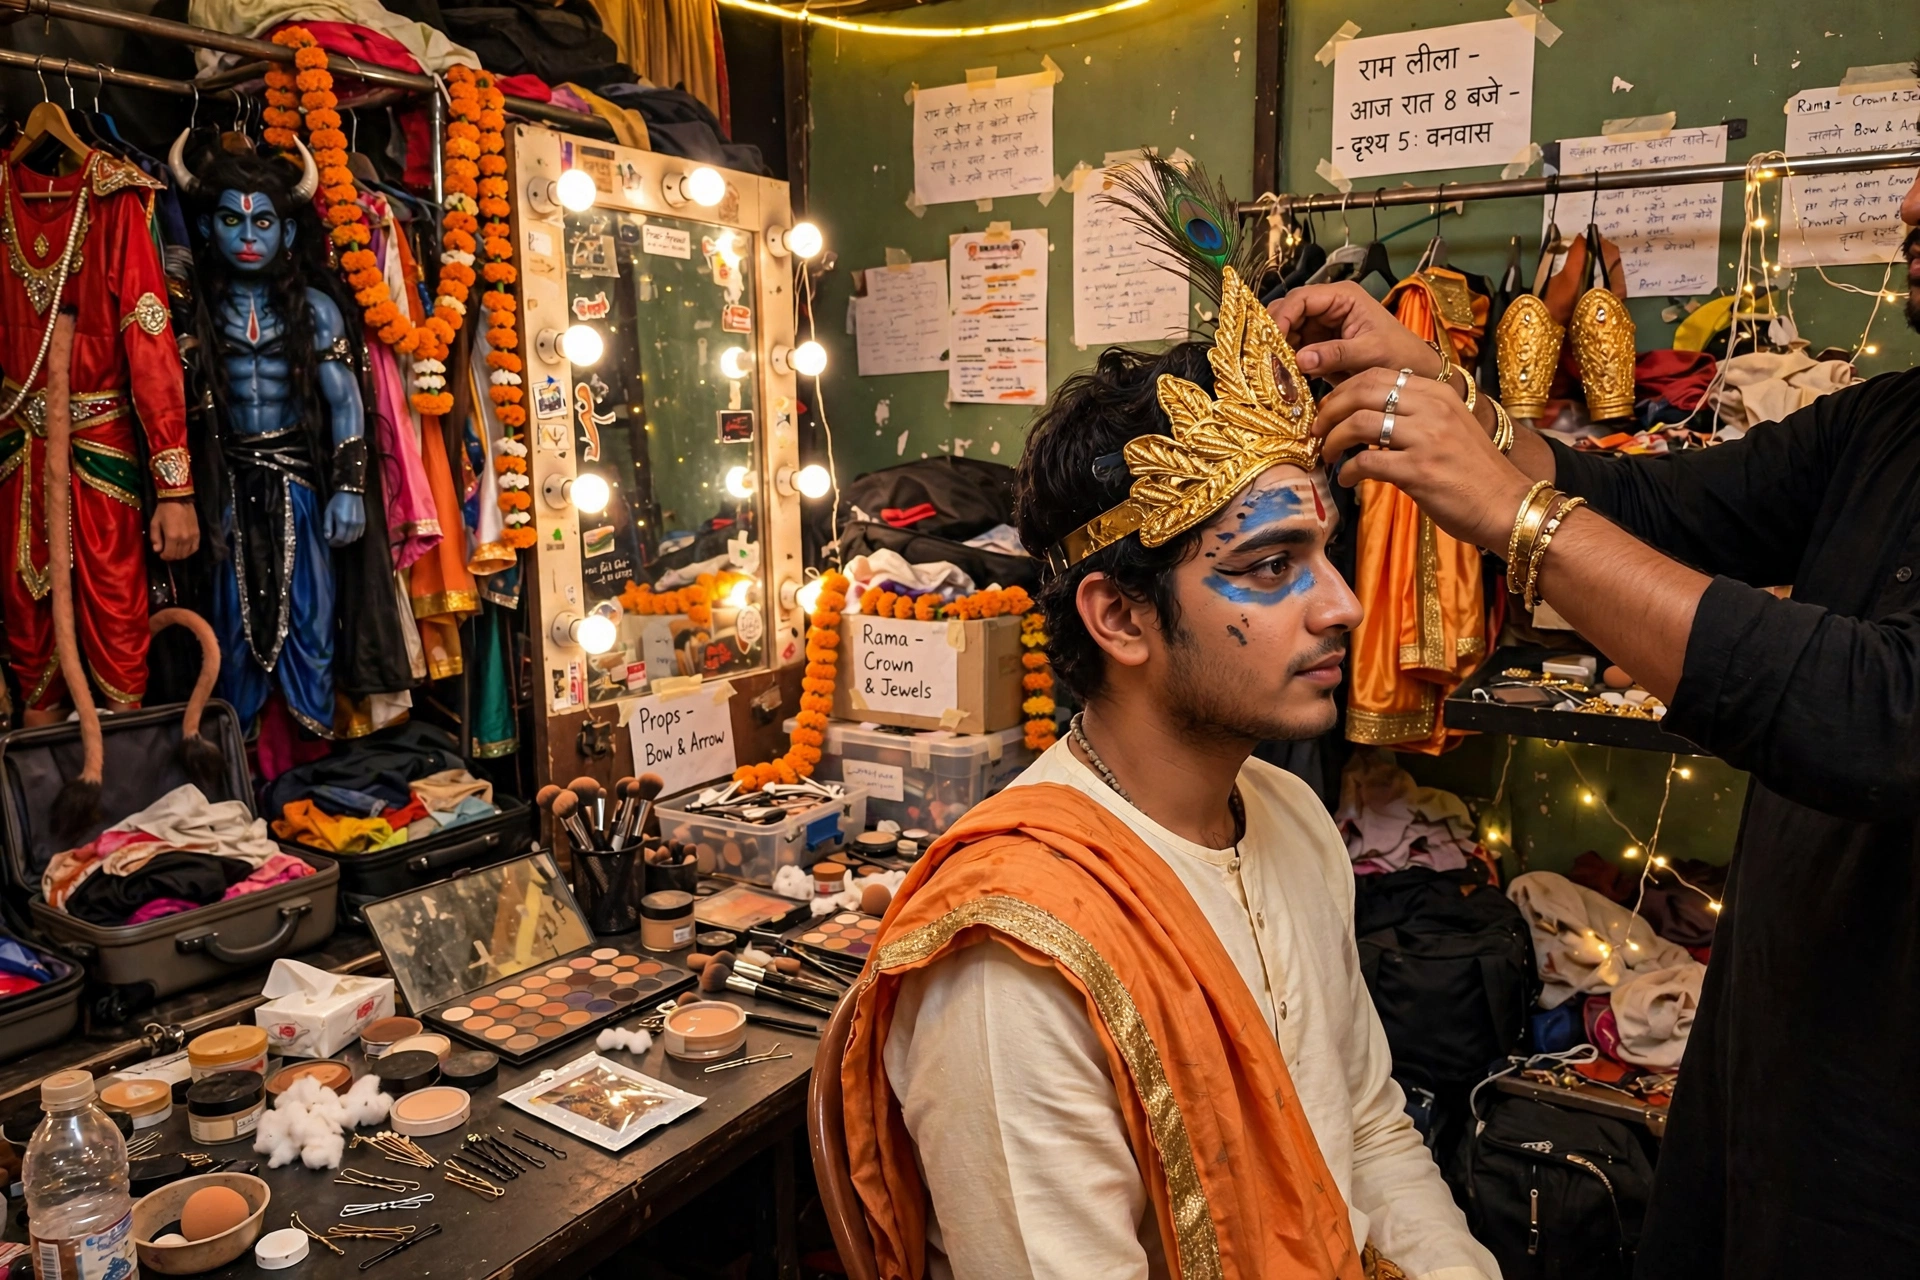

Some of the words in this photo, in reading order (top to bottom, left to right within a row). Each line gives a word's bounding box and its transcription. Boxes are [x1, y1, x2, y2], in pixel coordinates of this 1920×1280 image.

[1358, 55, 1397, 81] राम
[1405, 42, 1461, 75] लीला
[1350, 97, 1394, 121] आज
[1401, 92, 1435, 115] रात
[1444, 89, 1457, 111] 8
[1466, 75, 1503, 107] बजे
[1796, 97, 1832, 114] Rama
[1350, 133, 1391, 163] दृश्य
[1426, 122, 1494, 148] वनवास
[1854, 122, 1879, 137] Bow
[863, 623, 909, 647] Rama
[864, 650, 914, 673] Crown
[864, 677, 875, 694] &
[881, 677, 932, 699] Jewels
[639, 707, 681, 735] Props
[645, 742, 673, 767] Bow
[677, 737, 686, 756] &
[690, 731, 725, 753] Arrow
